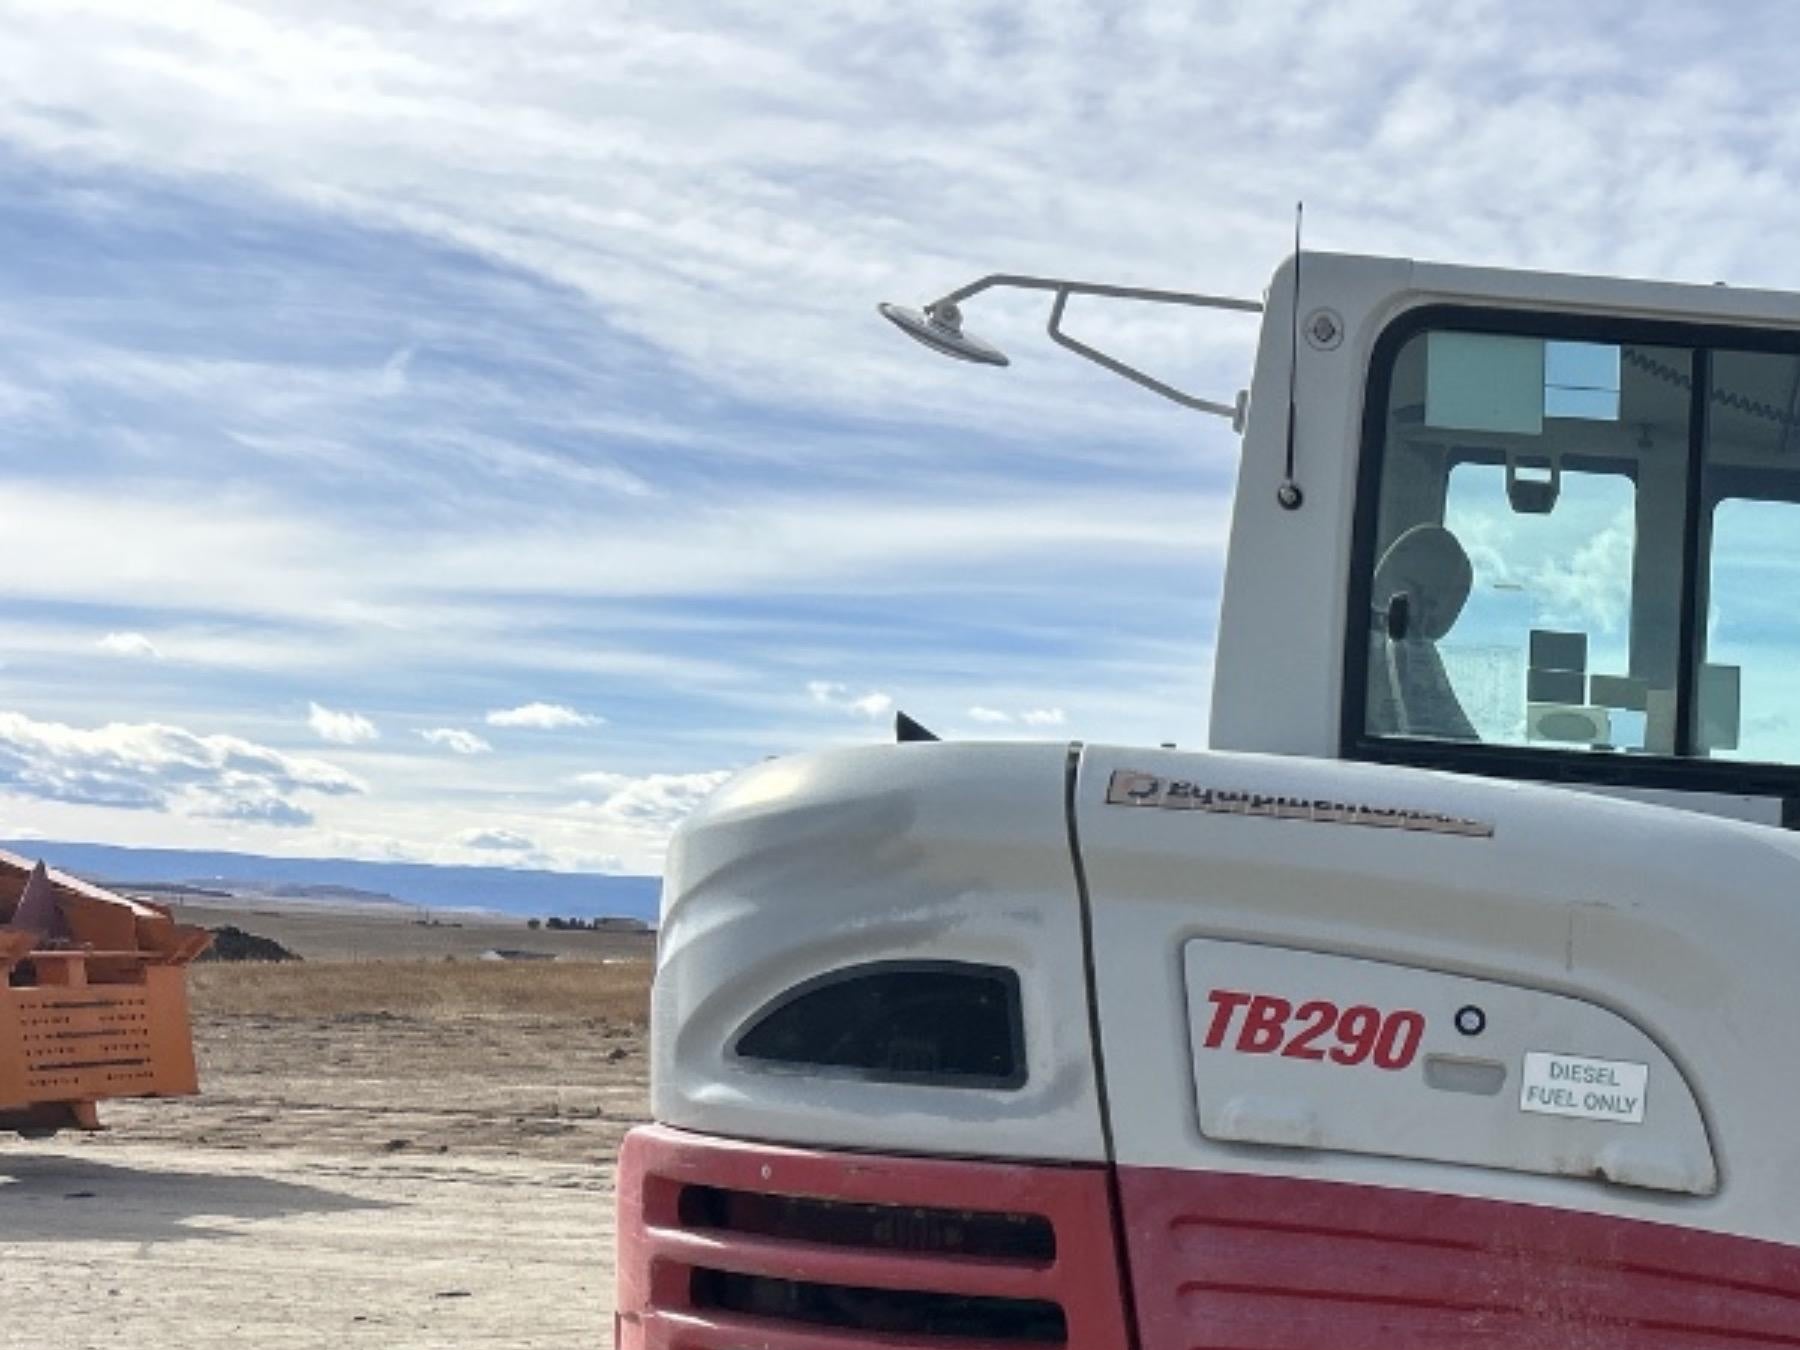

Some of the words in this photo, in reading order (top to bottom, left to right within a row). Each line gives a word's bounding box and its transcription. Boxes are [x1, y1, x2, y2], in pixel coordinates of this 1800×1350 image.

[1203, 989, 1426, 1070] TB290
[1550, 1061, 1621, 1087] DIESEL
[1527, 1085, 1579, 1107] FUEL
[1583, 1092, 1638, 1113] ONLY
